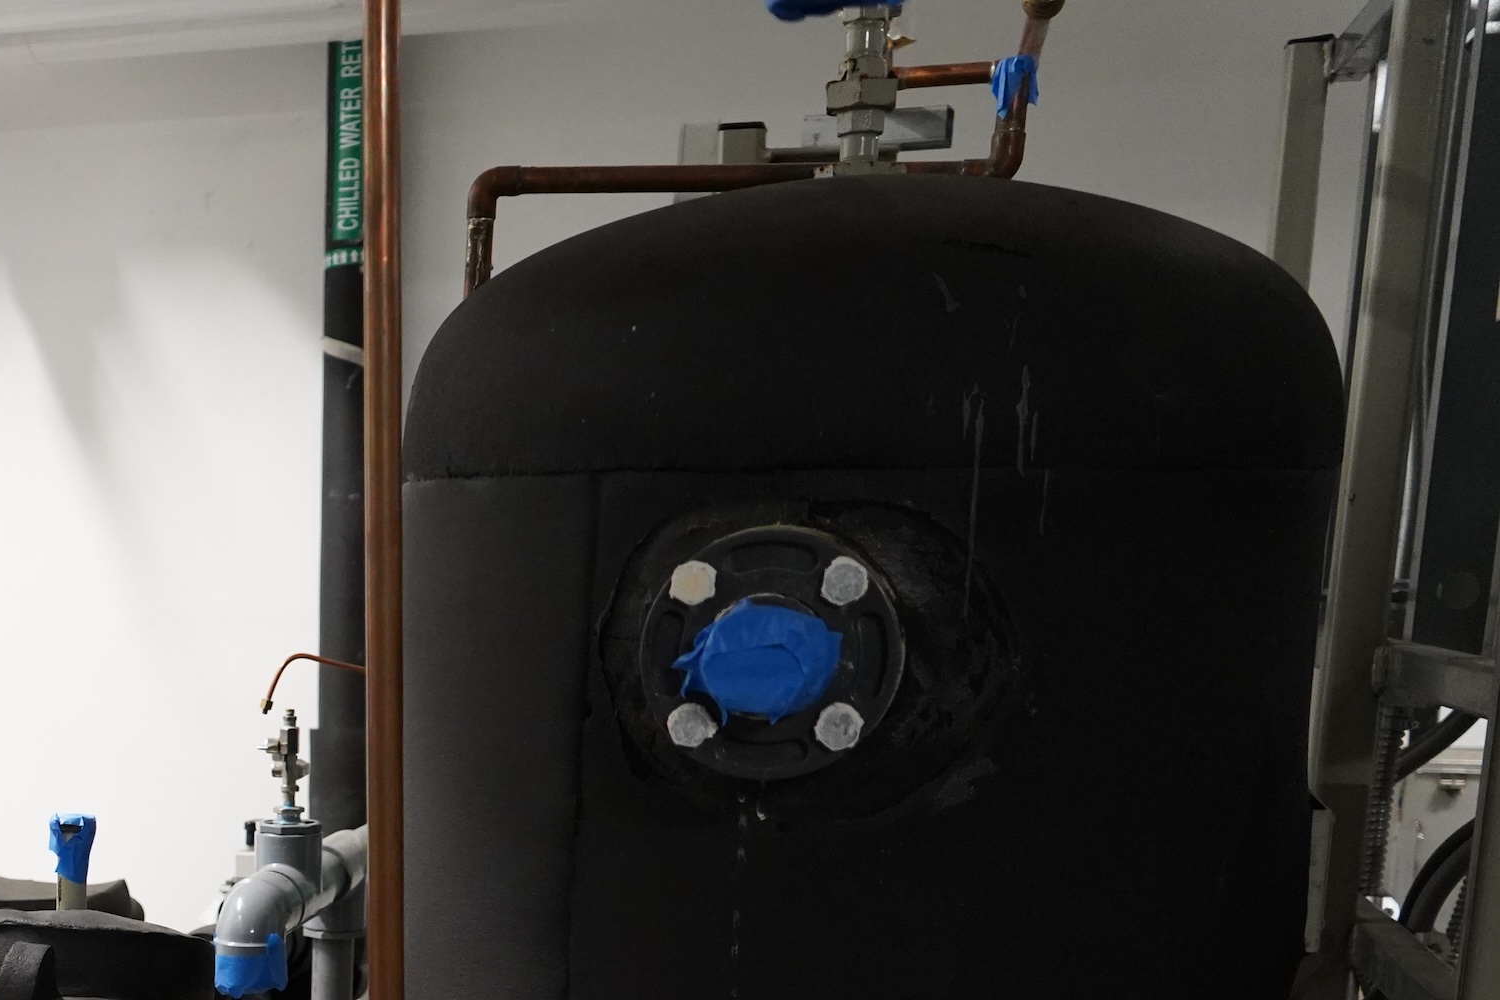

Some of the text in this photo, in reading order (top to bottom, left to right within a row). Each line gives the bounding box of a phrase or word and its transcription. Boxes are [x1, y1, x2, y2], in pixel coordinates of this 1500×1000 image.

[337, 39, 363, 231] CHILLED WATER RET
